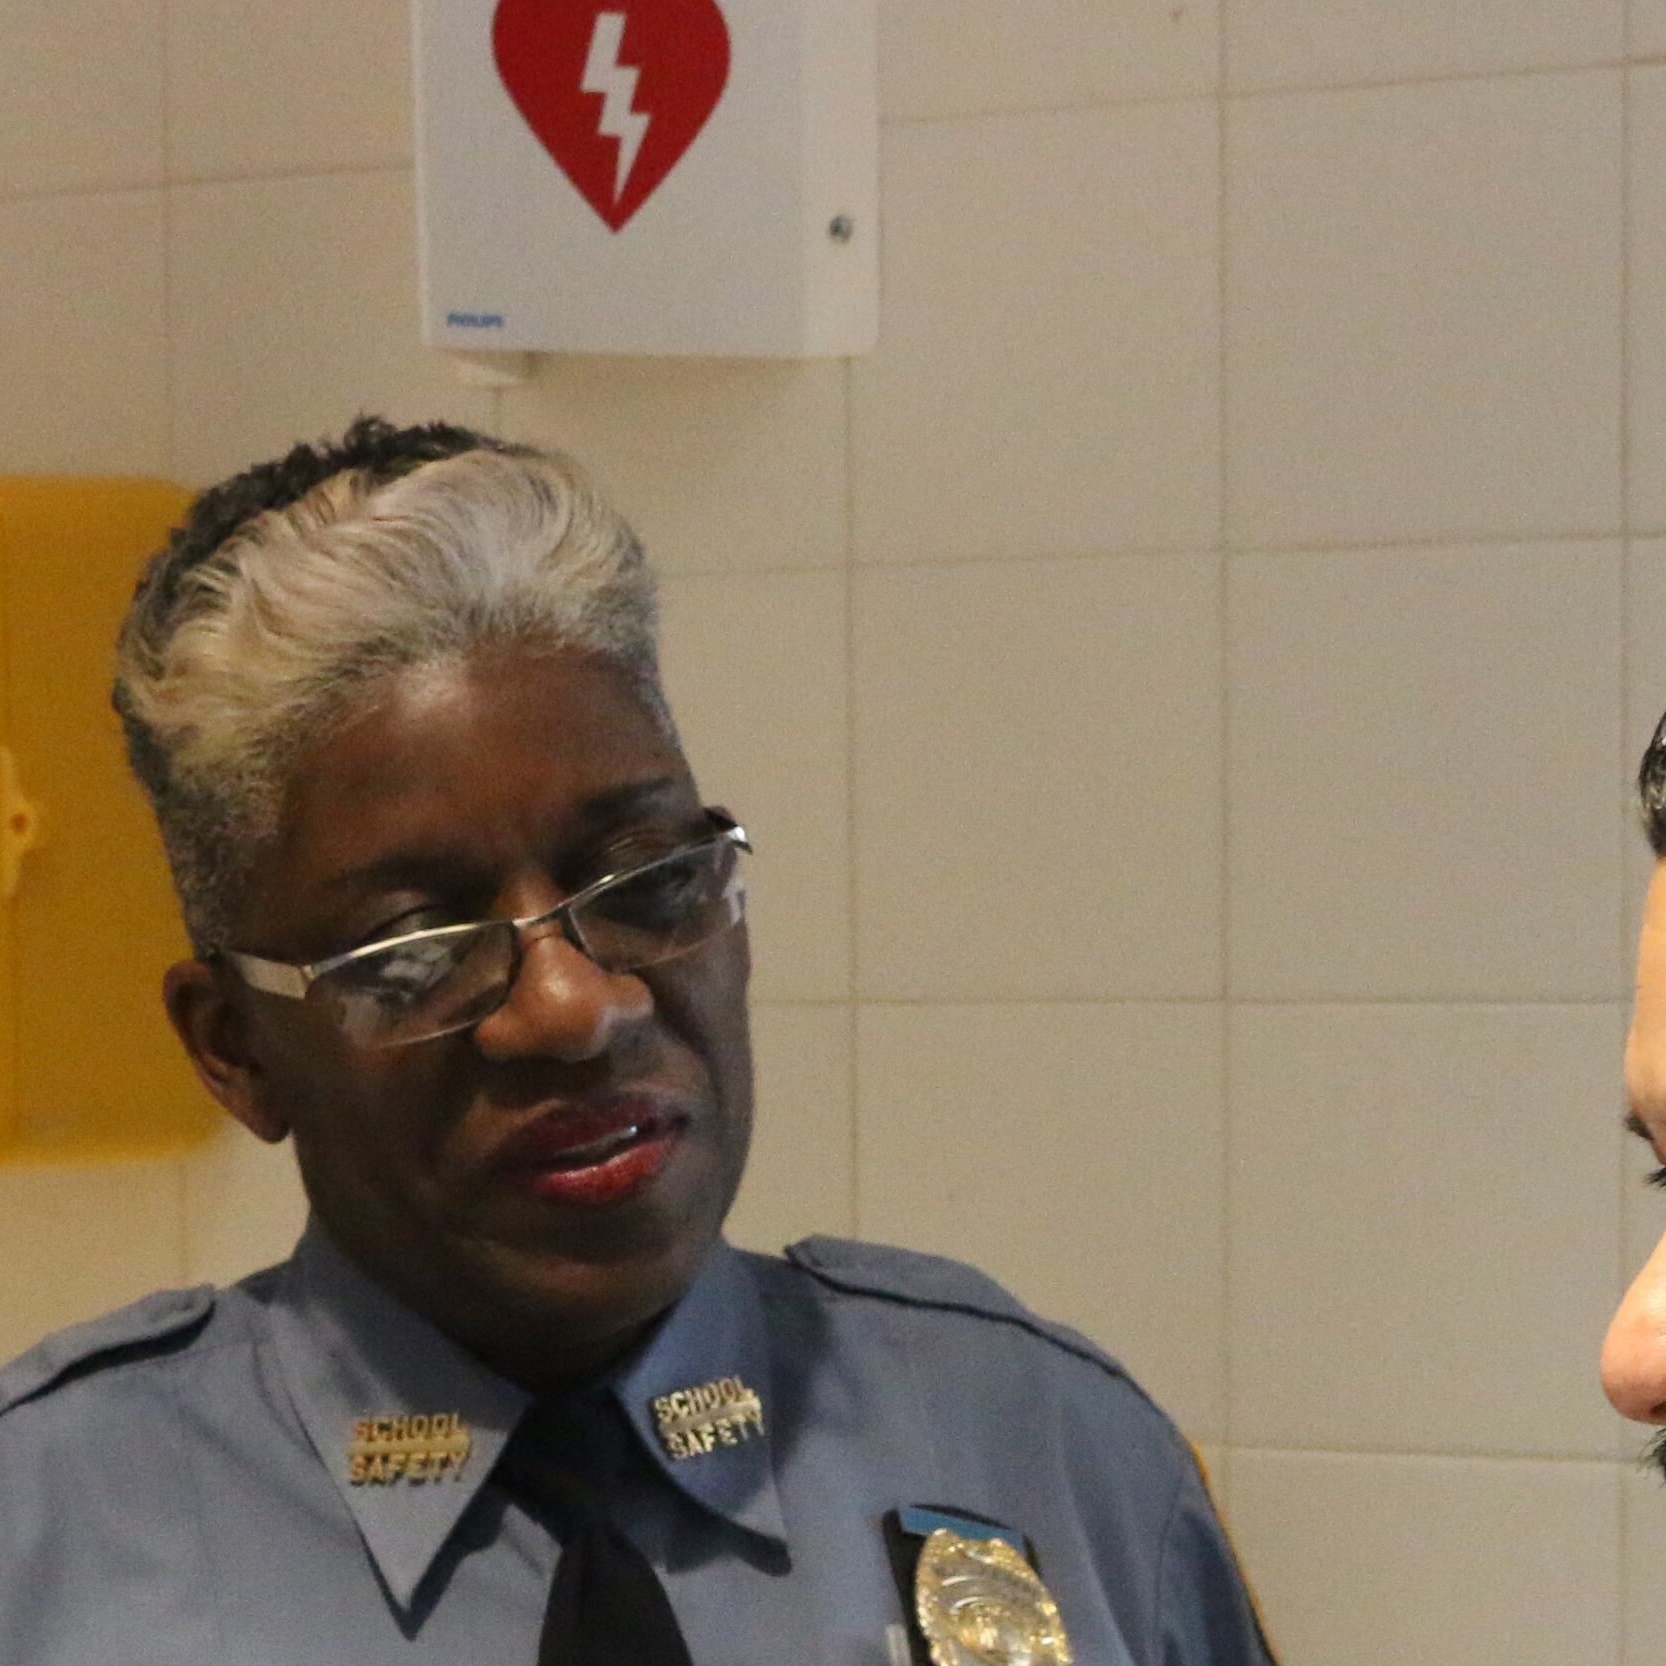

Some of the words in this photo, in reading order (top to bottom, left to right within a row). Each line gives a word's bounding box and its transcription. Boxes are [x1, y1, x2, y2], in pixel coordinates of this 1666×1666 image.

[653, 1374, 756, 1424] SCHOOL
[353, 1412, 465, 1443] SCHOOL
[666, 1411, 766, 1461] SAFETY
[349, 1451, 469, 1483] SAFETY
